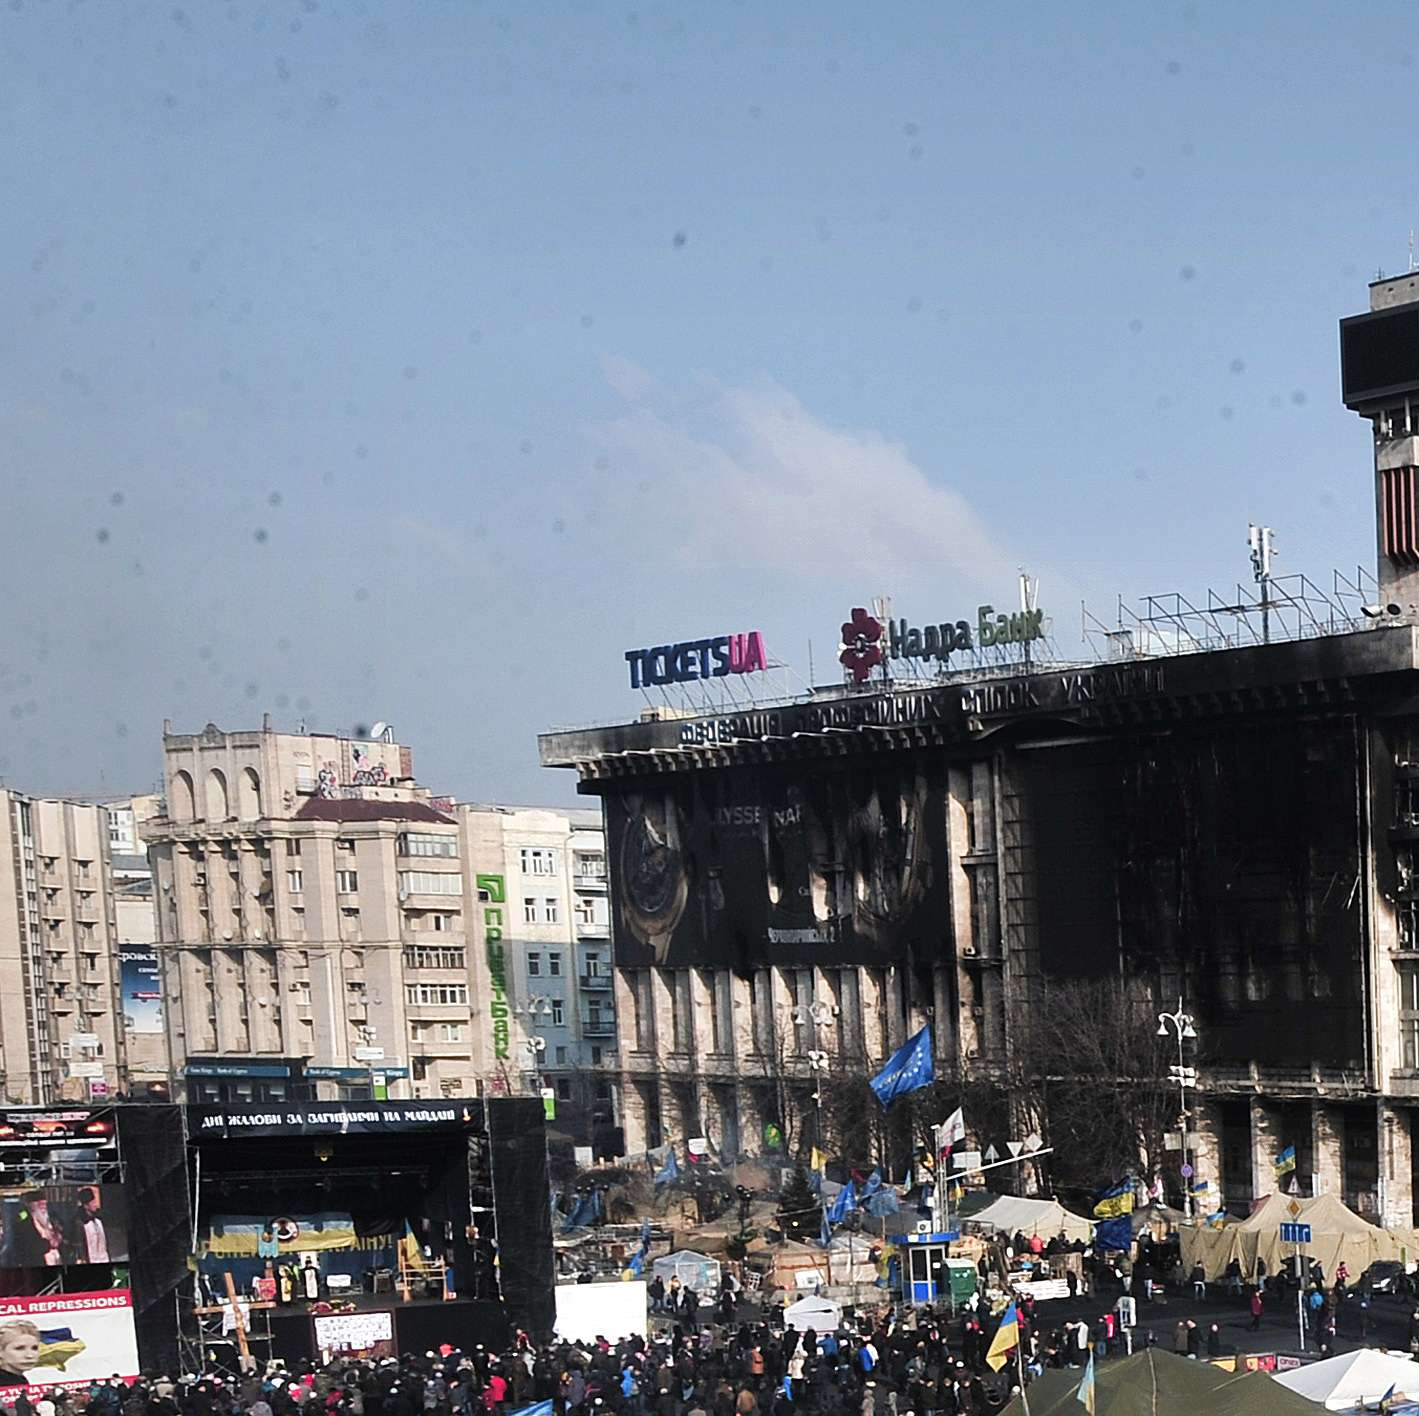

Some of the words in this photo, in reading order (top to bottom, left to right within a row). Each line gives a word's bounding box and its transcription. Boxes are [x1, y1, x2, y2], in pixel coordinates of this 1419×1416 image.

[888, 618, 973, 662] Надра
[977, 604, 1045, 646] Банк
[286, 1113, 303, 1125] ЗА
[384, 1111, 401, 1122] НА
[29, 1296, 128, 1313] REPRESSIONS
